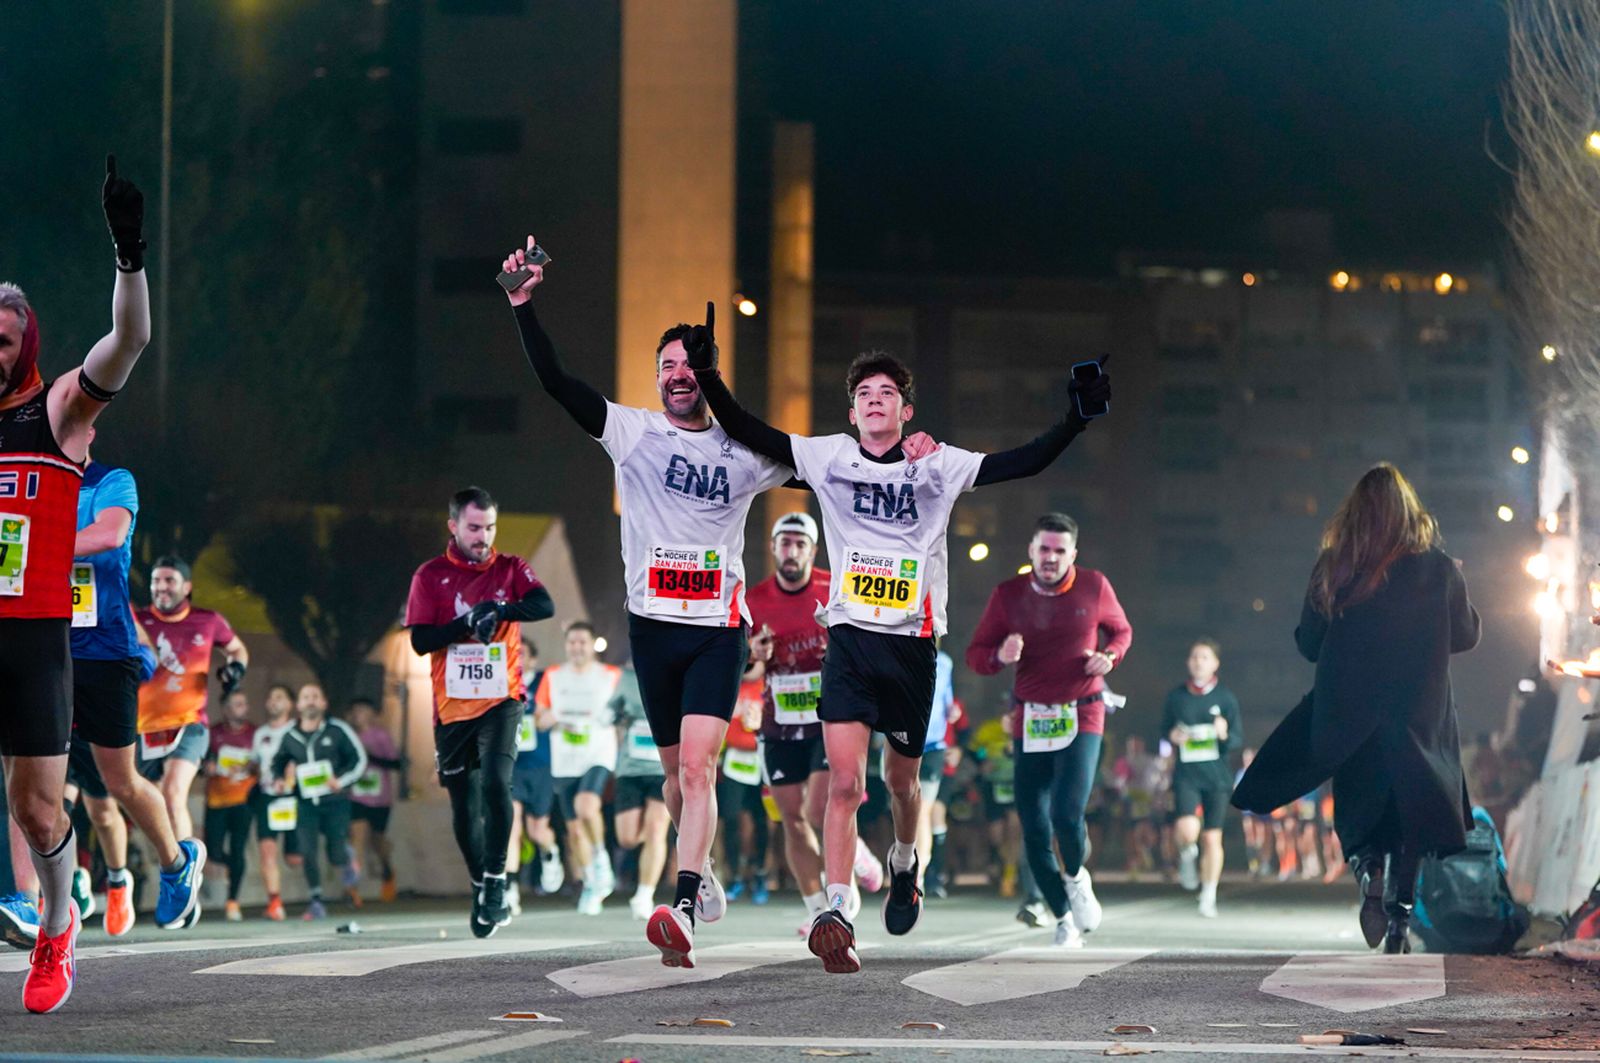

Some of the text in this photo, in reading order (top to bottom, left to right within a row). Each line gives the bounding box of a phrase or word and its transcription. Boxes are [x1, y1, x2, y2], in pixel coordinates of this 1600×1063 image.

[665, 454, 730, 504] ENA
[852, 482, 919, 520] ENA
[655, 559, 671, 568] SAN
[664, 552, 698, 561] NOCHE DE
[860, 556, 883, 567] NOCHE
[884, 559, 894, 568] DE
[851, 564, 866, 574] SAN
[656, 569, 715, 592] 13494
[852, 574, 910, 602] 12916
[459, 664, 493, 680] 7158
